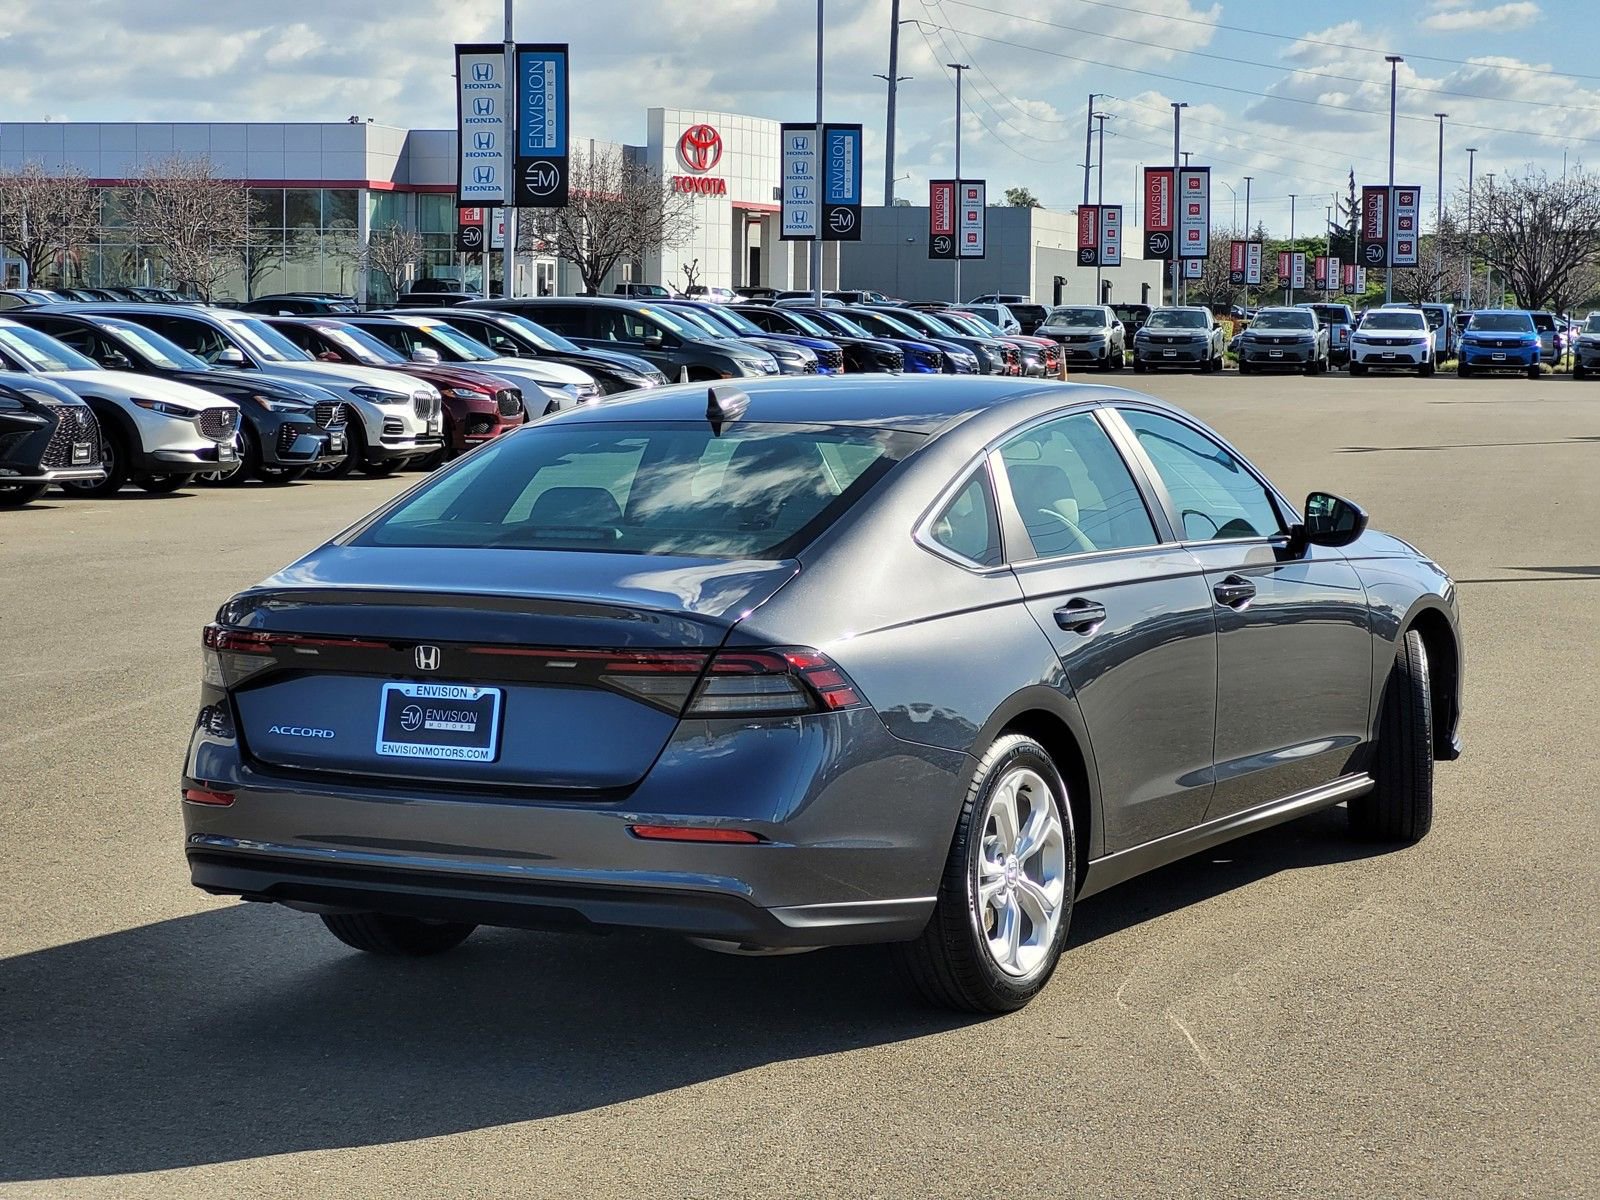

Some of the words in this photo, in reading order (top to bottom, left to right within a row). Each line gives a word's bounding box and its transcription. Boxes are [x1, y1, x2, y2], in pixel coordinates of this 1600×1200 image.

[528, 60, 544, 148] ENVISION
[832, 136, 844, 198] ENVISION
[672, 176, 728, 195] TOYOTA
[1152, 176, 1160, 226] ENVISION
[1368, 194, 1376, 238] ENVISION
[416, 686, 468, 698] ENVISION
[426, 708, 478, 722] ENVISION
[268, 726, 335, 738] ACCORD
[382, 744, 489, 759] ENVISIONMOTORS.COM
